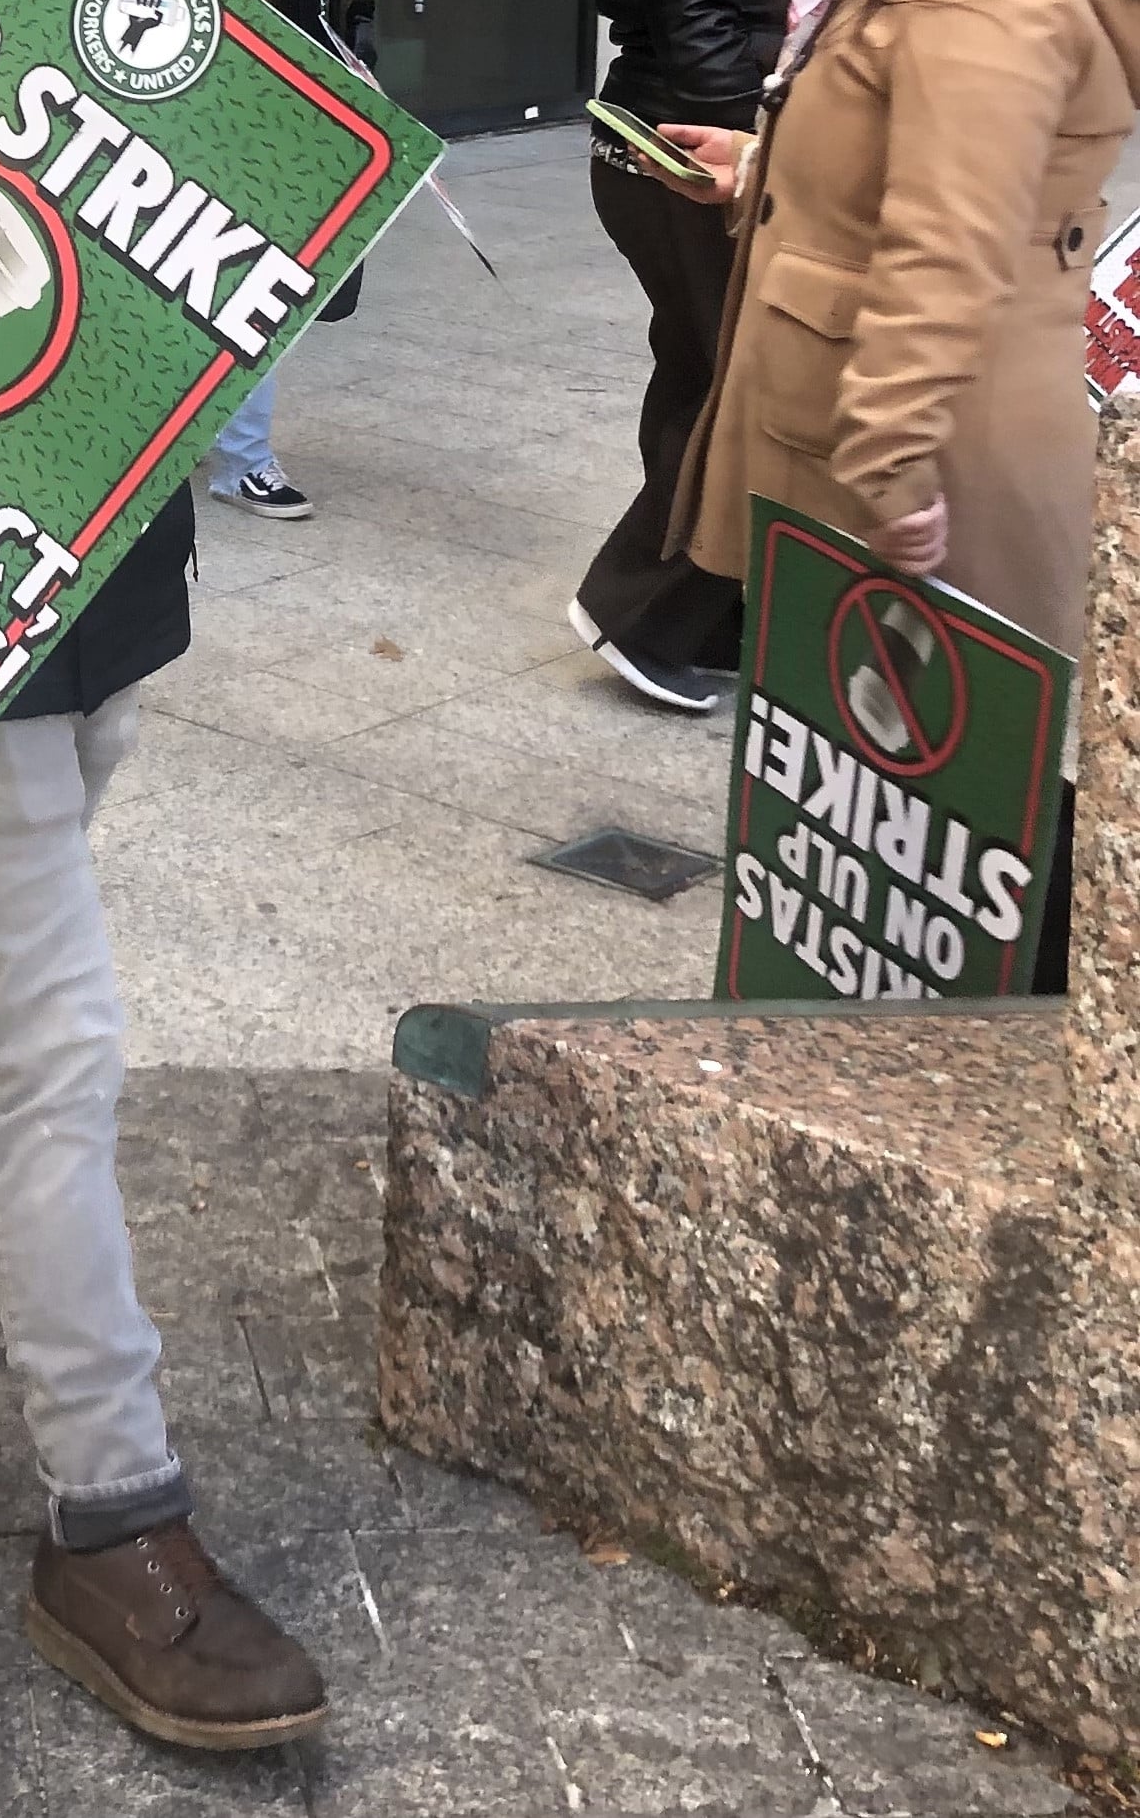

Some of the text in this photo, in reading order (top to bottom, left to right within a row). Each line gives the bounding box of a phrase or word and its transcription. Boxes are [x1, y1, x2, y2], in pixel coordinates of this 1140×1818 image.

[130, 55, 195, 90] UNITED
[745, 693, 1033, 942] STRIKE!
[777, 822, 965, 981] ON ULP
